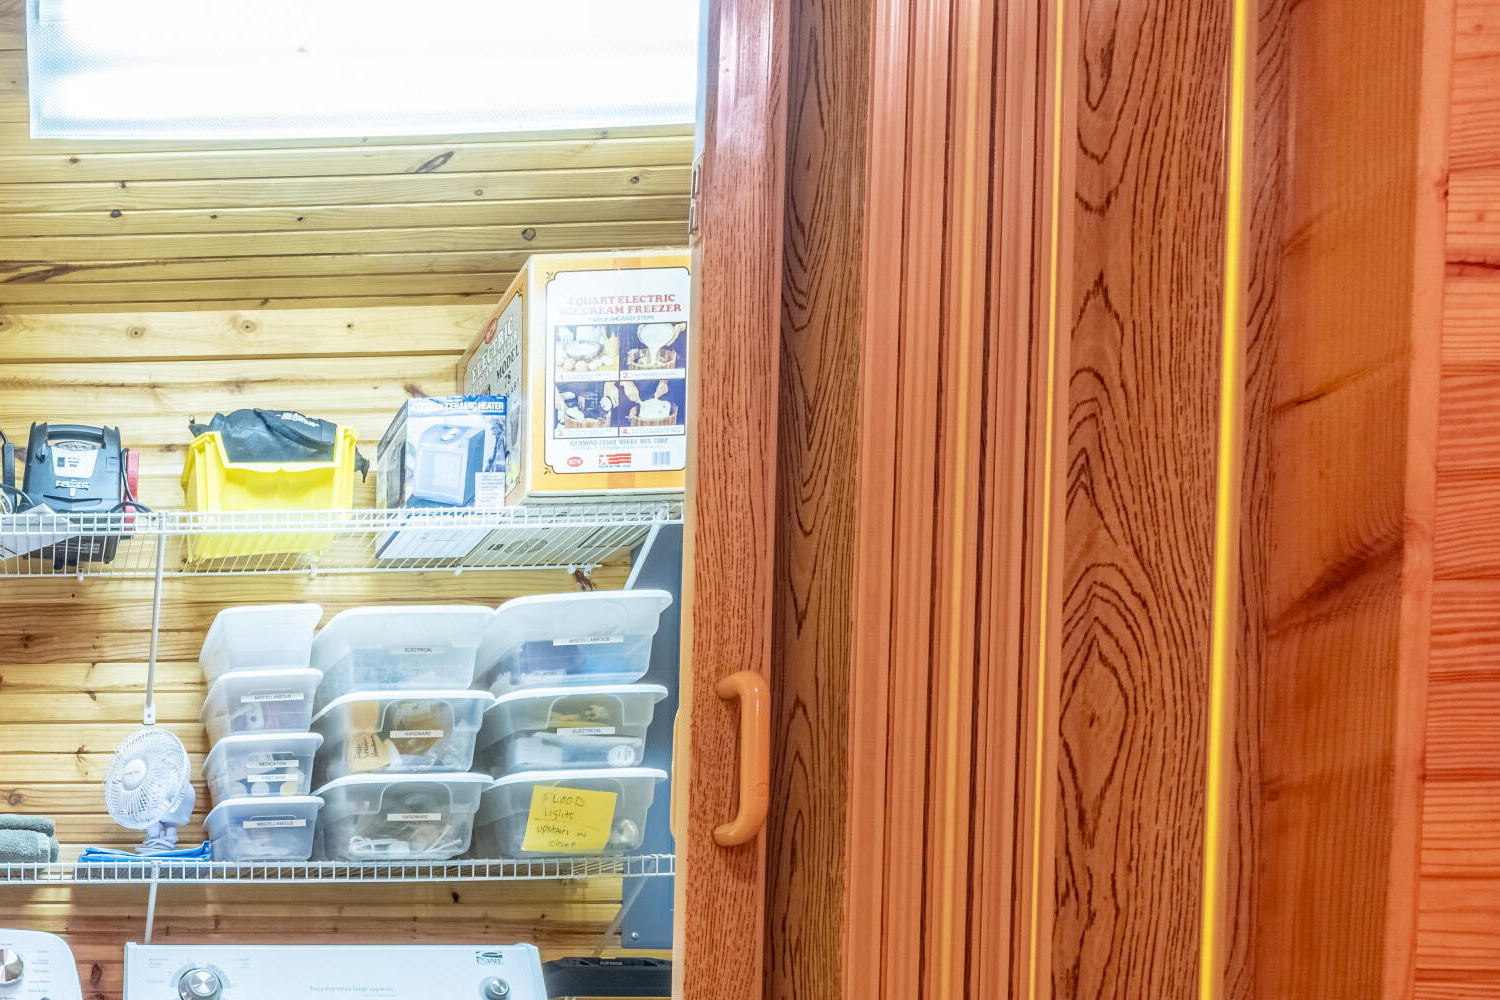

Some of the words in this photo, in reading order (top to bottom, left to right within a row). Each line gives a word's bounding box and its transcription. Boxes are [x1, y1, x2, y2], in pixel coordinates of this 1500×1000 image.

[576, 296, 616, 306] QUART
[618, 294, 676, 304] ELECTRIC
[583, 306, 625, 315] CREAM
[627, 303, 682, 314] FREEZER
[543, 792, 586, 807] FLOOD
